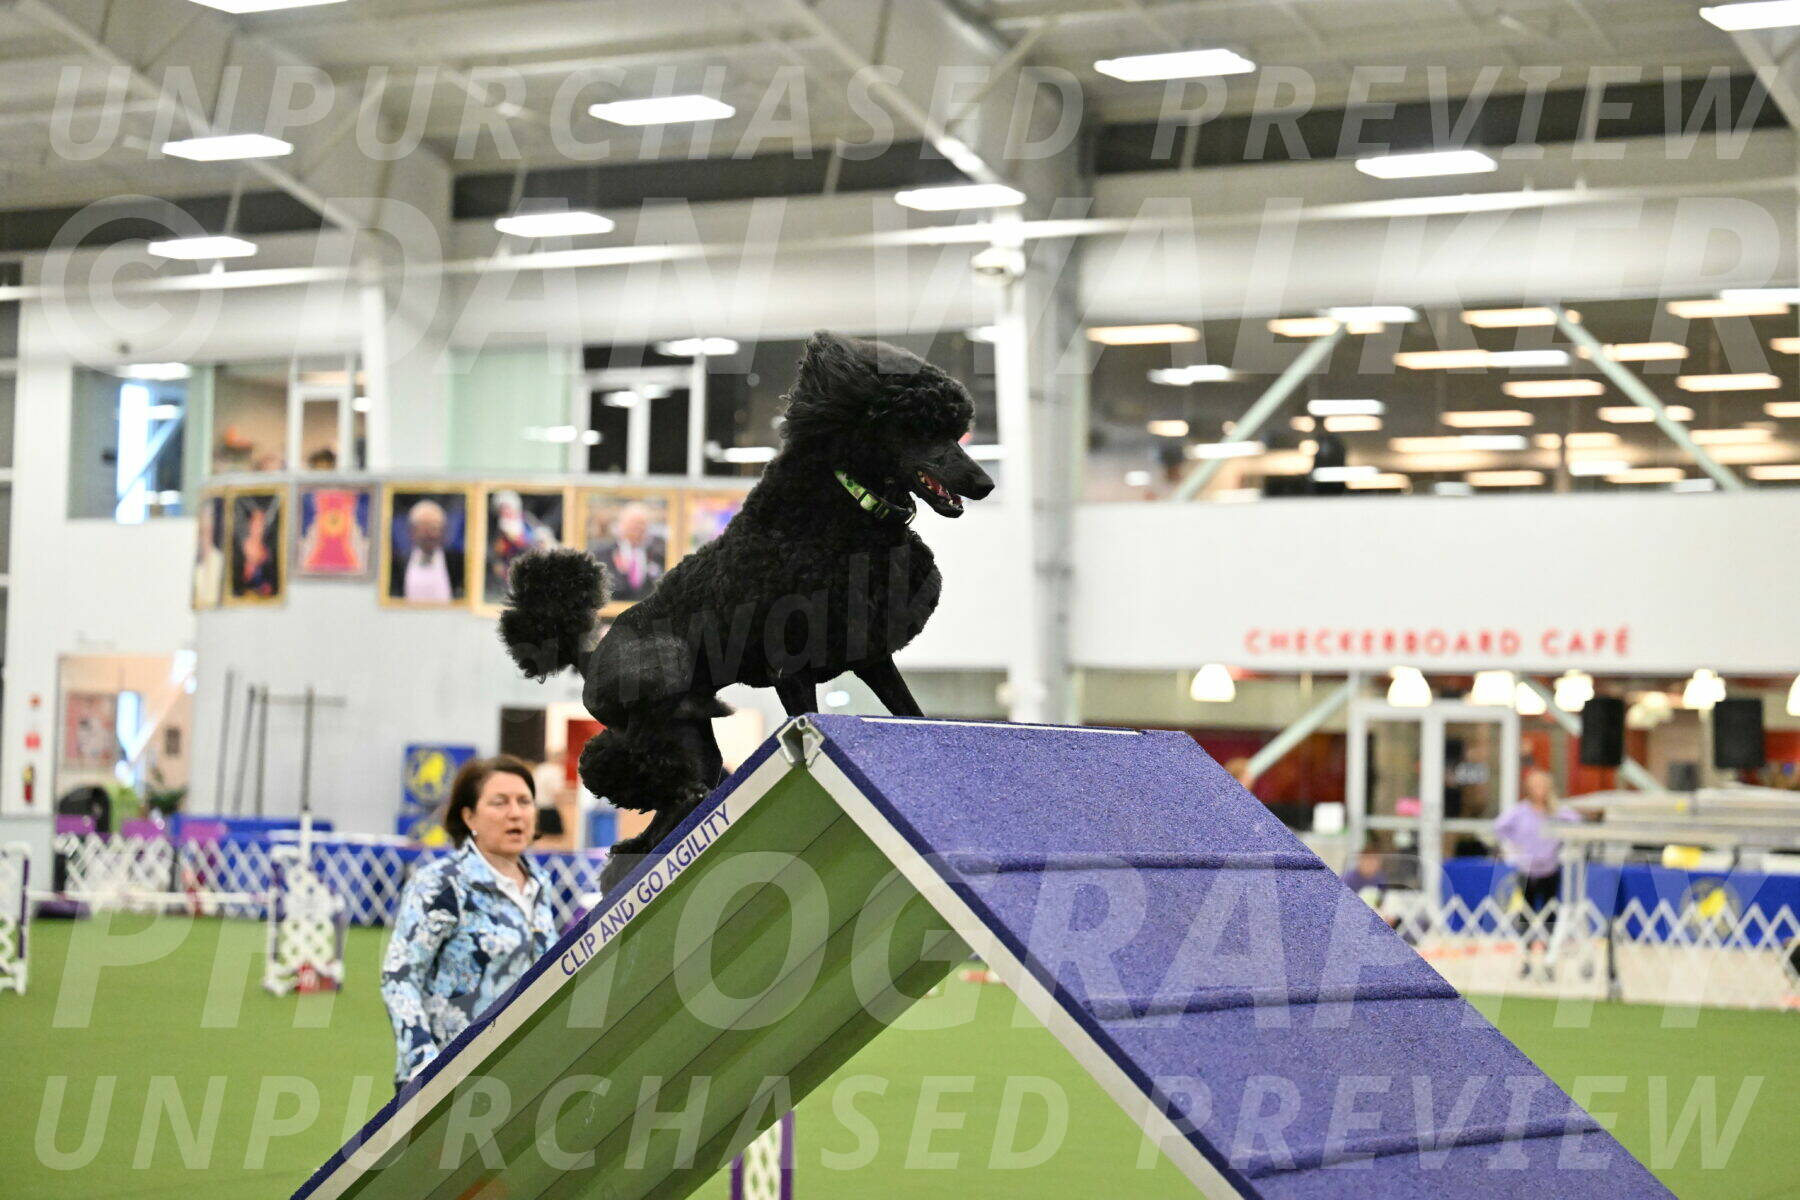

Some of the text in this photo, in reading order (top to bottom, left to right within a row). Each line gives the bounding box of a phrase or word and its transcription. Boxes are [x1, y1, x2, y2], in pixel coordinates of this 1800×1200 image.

[1244, 624, 1631, 657] CHECKERBOARD CAFÉ
[560, 803, 731, 976] CLIP AND GO AGILITY
